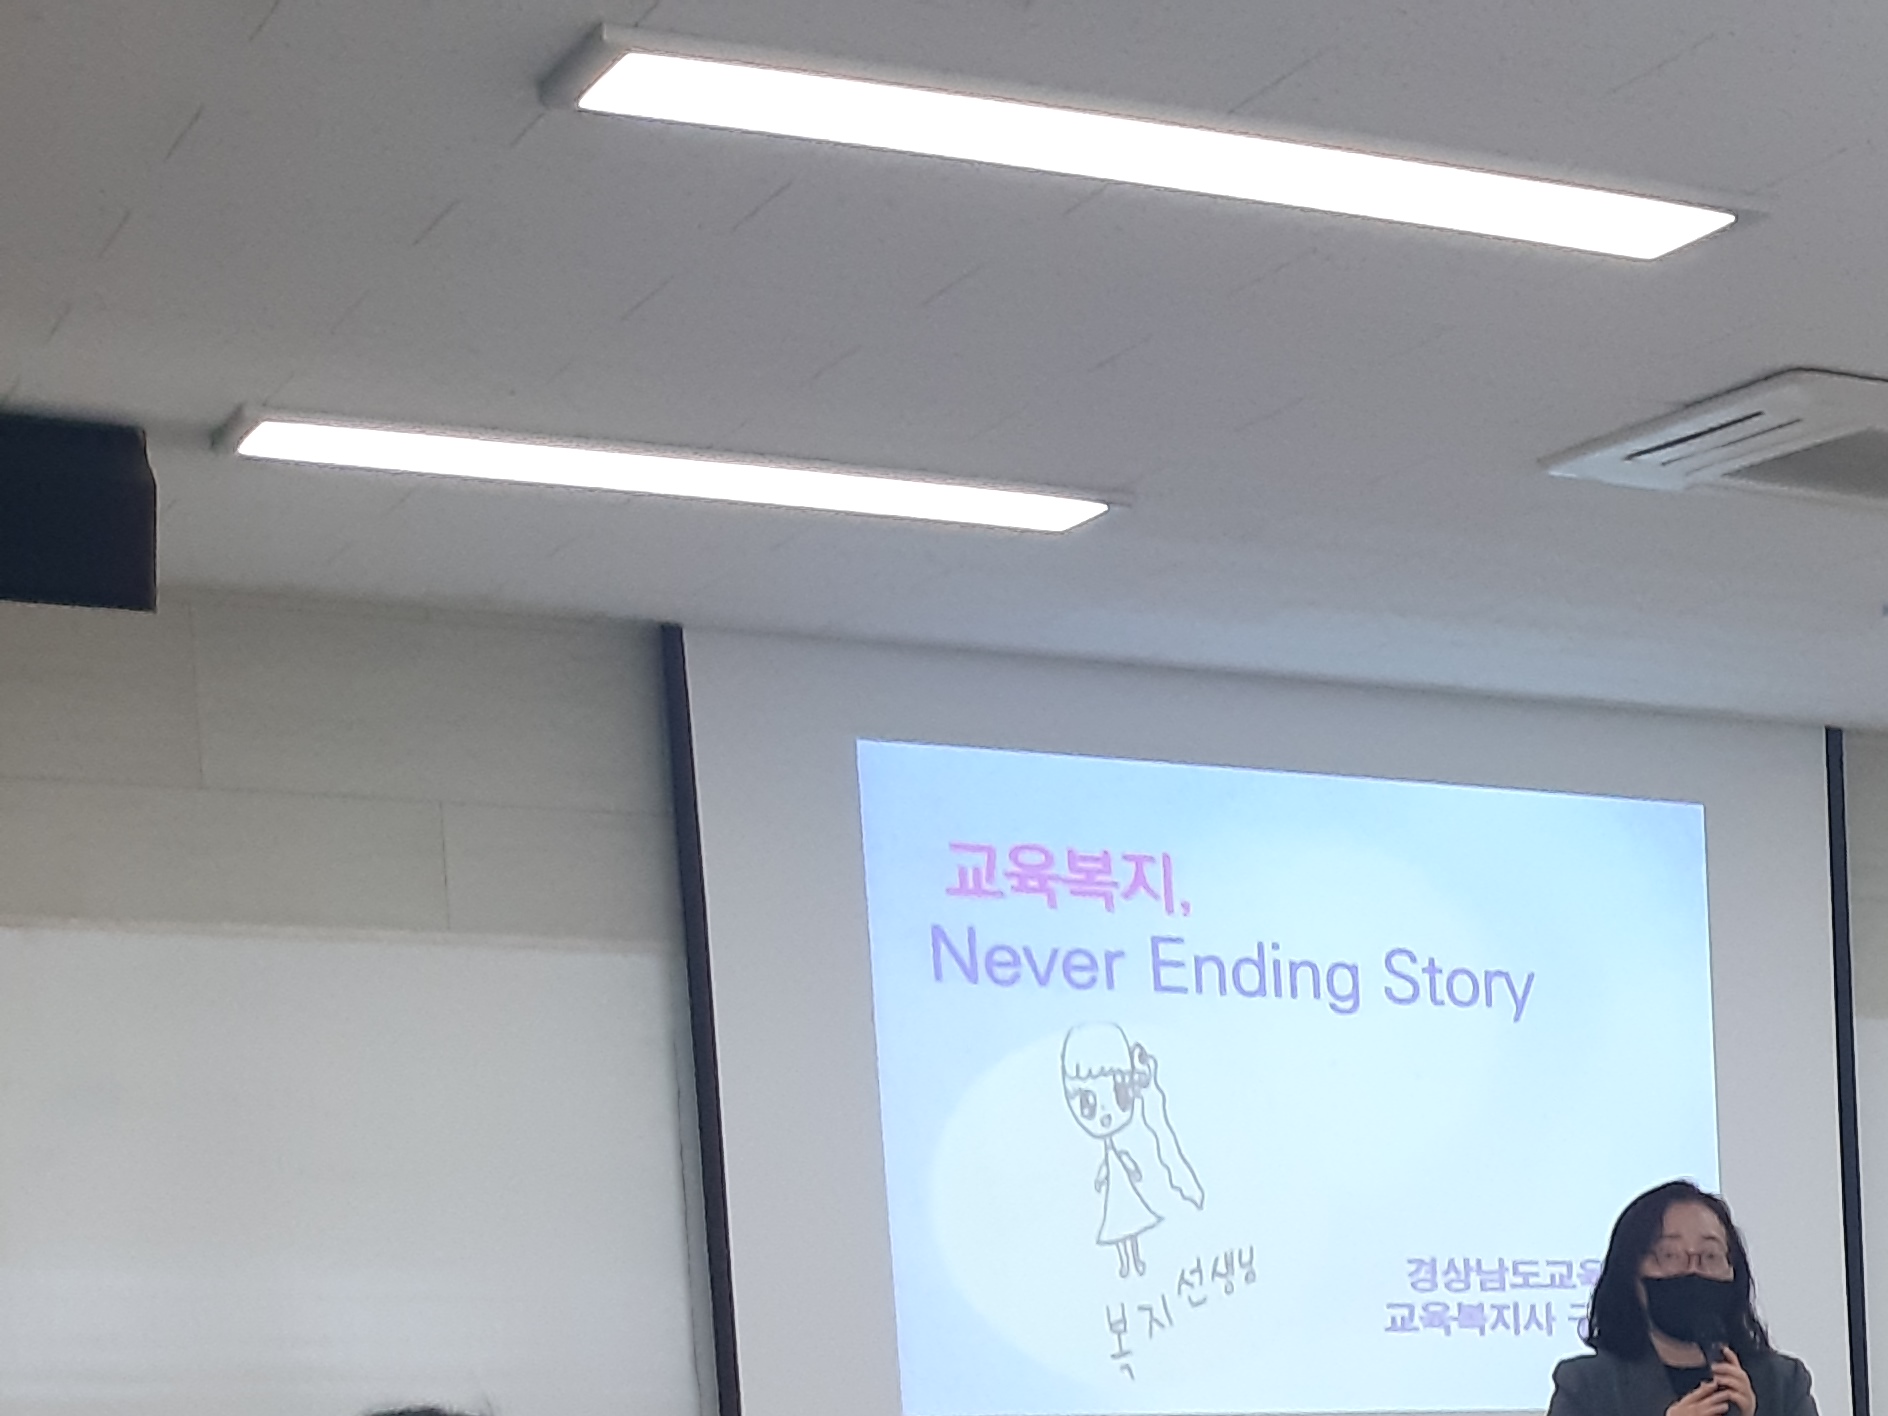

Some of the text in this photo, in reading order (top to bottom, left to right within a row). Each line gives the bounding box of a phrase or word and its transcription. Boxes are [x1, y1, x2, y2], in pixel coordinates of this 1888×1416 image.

[944, 842, 1193, 916] 교육복지,
[929, 925, 1537, 1024] Never Ending Story
[1384, 1301, 1556, 1337] 교육복지사
